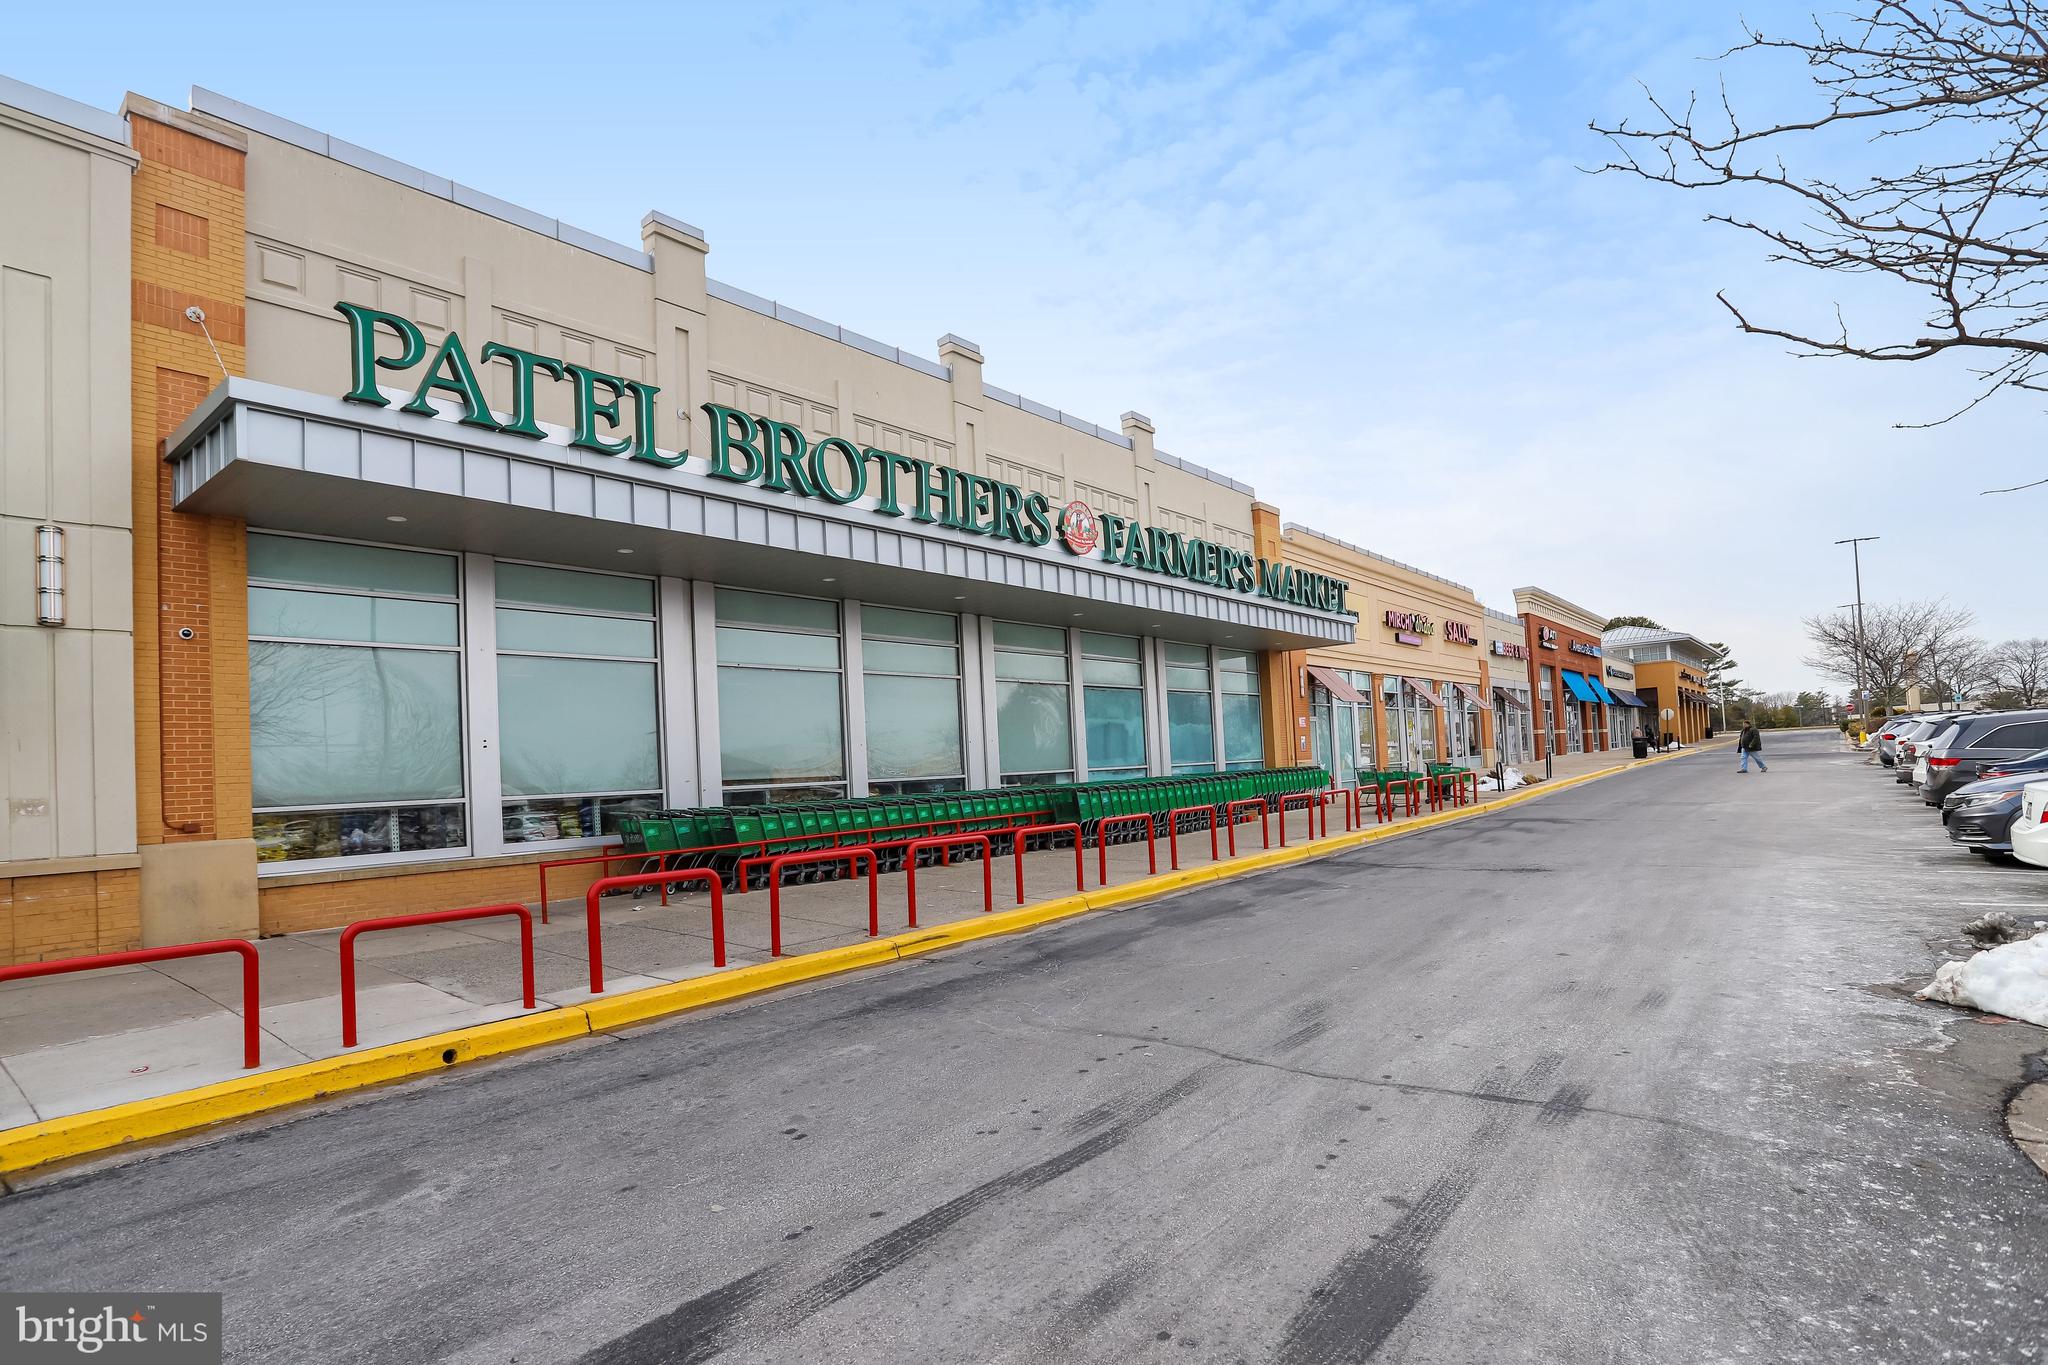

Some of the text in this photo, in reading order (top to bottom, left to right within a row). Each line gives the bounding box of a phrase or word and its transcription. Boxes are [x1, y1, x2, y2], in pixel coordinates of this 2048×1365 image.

[334, 301, 689, 469] PATEL
[701, 402, 1052, 547] BROTHERS
[1099, 513, 1256, 594] FARMER'S
[1258, 558, 1350, 615] MARKET
[1387, 610, 1412, 632] MIRCHI
[1446, 620, 1470, 644] SALLY
